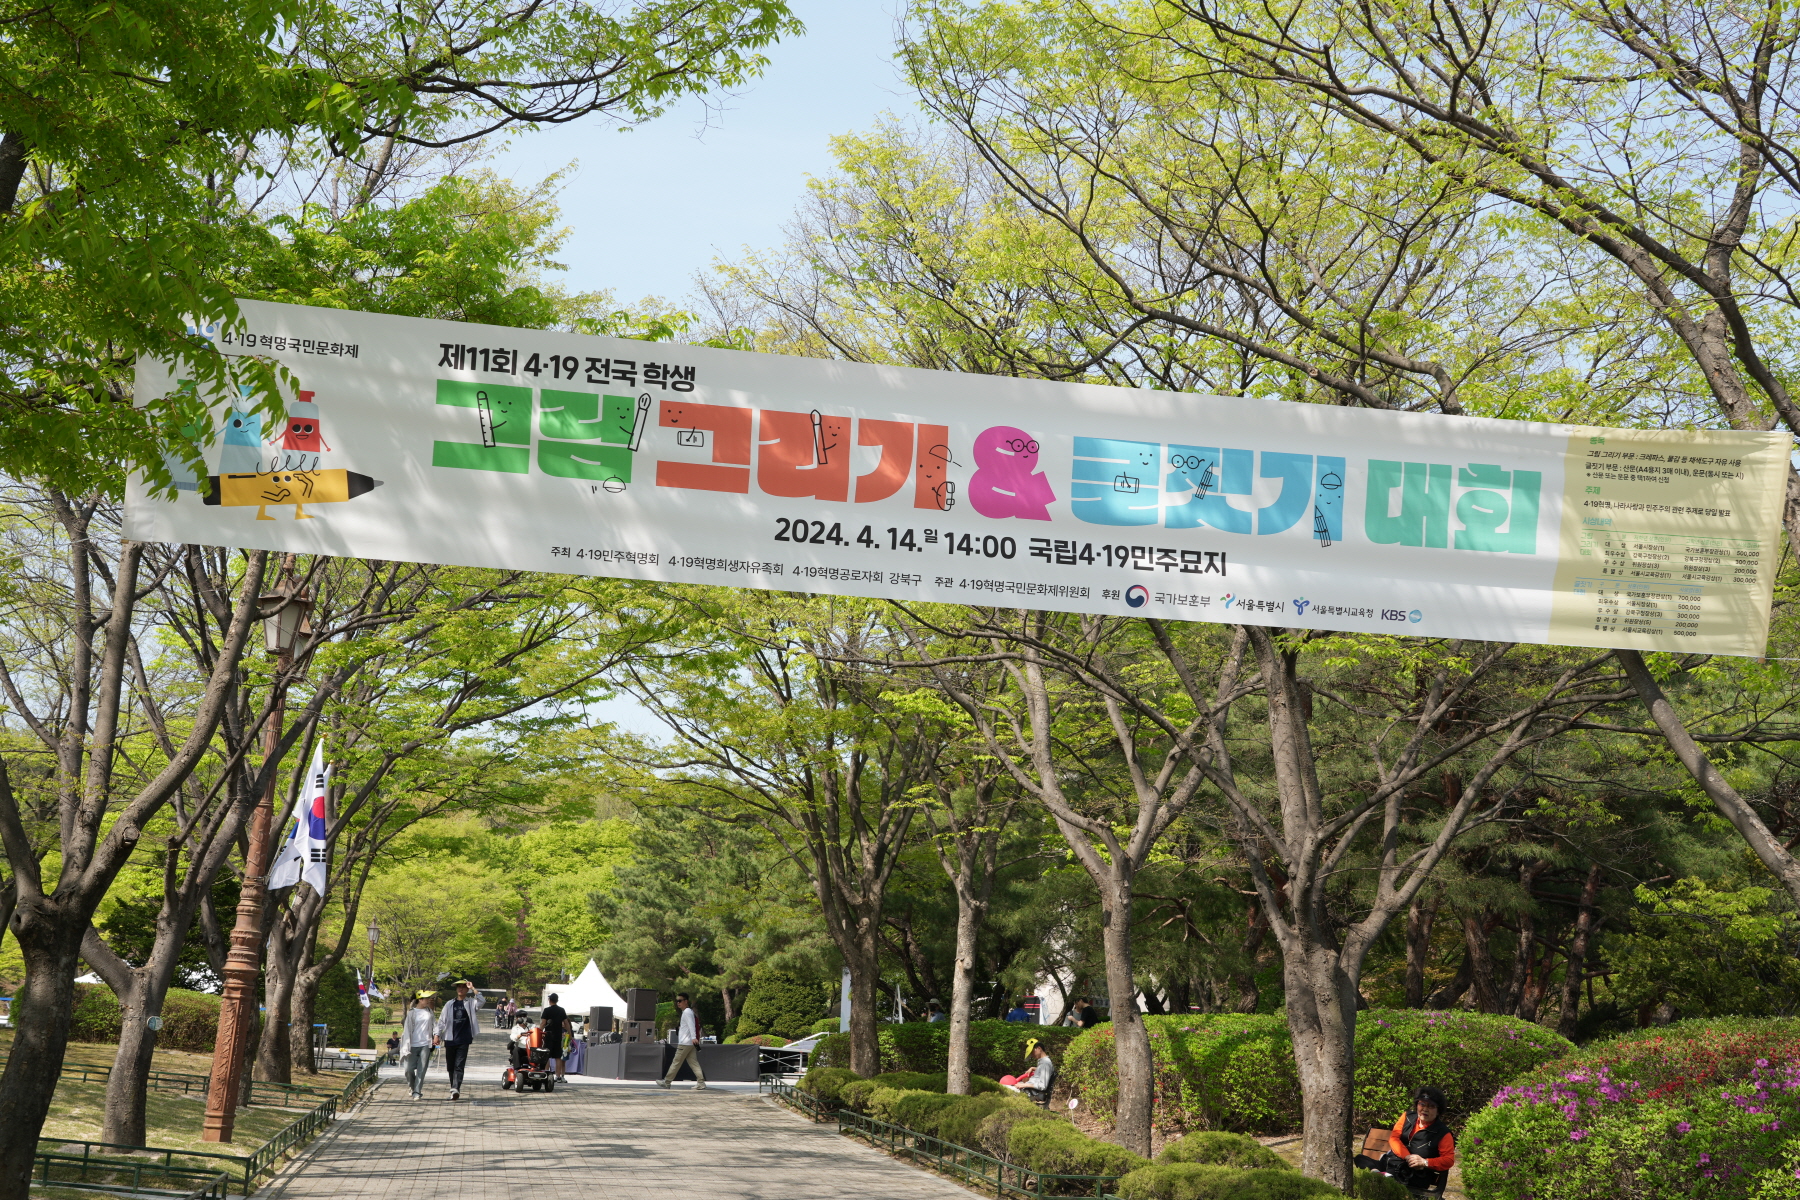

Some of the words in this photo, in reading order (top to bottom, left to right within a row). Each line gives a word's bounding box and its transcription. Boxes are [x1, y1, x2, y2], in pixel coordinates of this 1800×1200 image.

[260, 334, 360, 359] 혁명국민문화제
[438, 343, 517, 376] 제11회
[523, 352, 579, 381] 4·19
[585, 356, 637, 387] 전국
[643, 362, 696, 393] 학생
[431, 378, 636, 484] 그림
[655, 399, 949, 511] 그리기
[967, 425, 1057, 522] &
[1070, 435, 1346, 542] 글짓기
[1364, 458, 1542, 555] 대회
[1585, 462, 1605, 471] 글짓기
[1606, 463, 1618, 471] 부문
[1587, 450, 1600, 458] 그림
[1601, 451, 1621, 459] 그리기
[1622, 452, 1635, 460] 부문
[1715, 458, 1727, 466] 자유
[1729, 459, 1742, 467] 사용
[1585, 486, 1601, 495] 주제
[1646, 504, 1670, 513] 민주주의
[774, 517, 850, 547] 2024.
[856, 525, 880, 549] 4.
[944, 532, 1017, 560] 14:00
[1028, 537, 1228, 576] 국립4·19민주묘지
[550, 546, 571, 558] 주최
[576, 548, 660, 566] 4·19민주혁명회
[668, 555, 784, 576] 4·19혁명희생자유족회
[792, 565, 883, 584] 4·19혁명공로자회
[889, 572, 922, 587] 강북구
[934, 577, 954, 588] 주관
[958, 578, 1091, 600] 4·19혁명국민문화제위원회
[1101, 589, 1120, 601] 후원
[1154, 592, 1211, 608] 국가보훈부
[1236, 598, 1285, 613] 서울특별시
[1311, 604, 1374, 619] 서울특별시교육청
[1380, 608, 1407, 622] KBS
